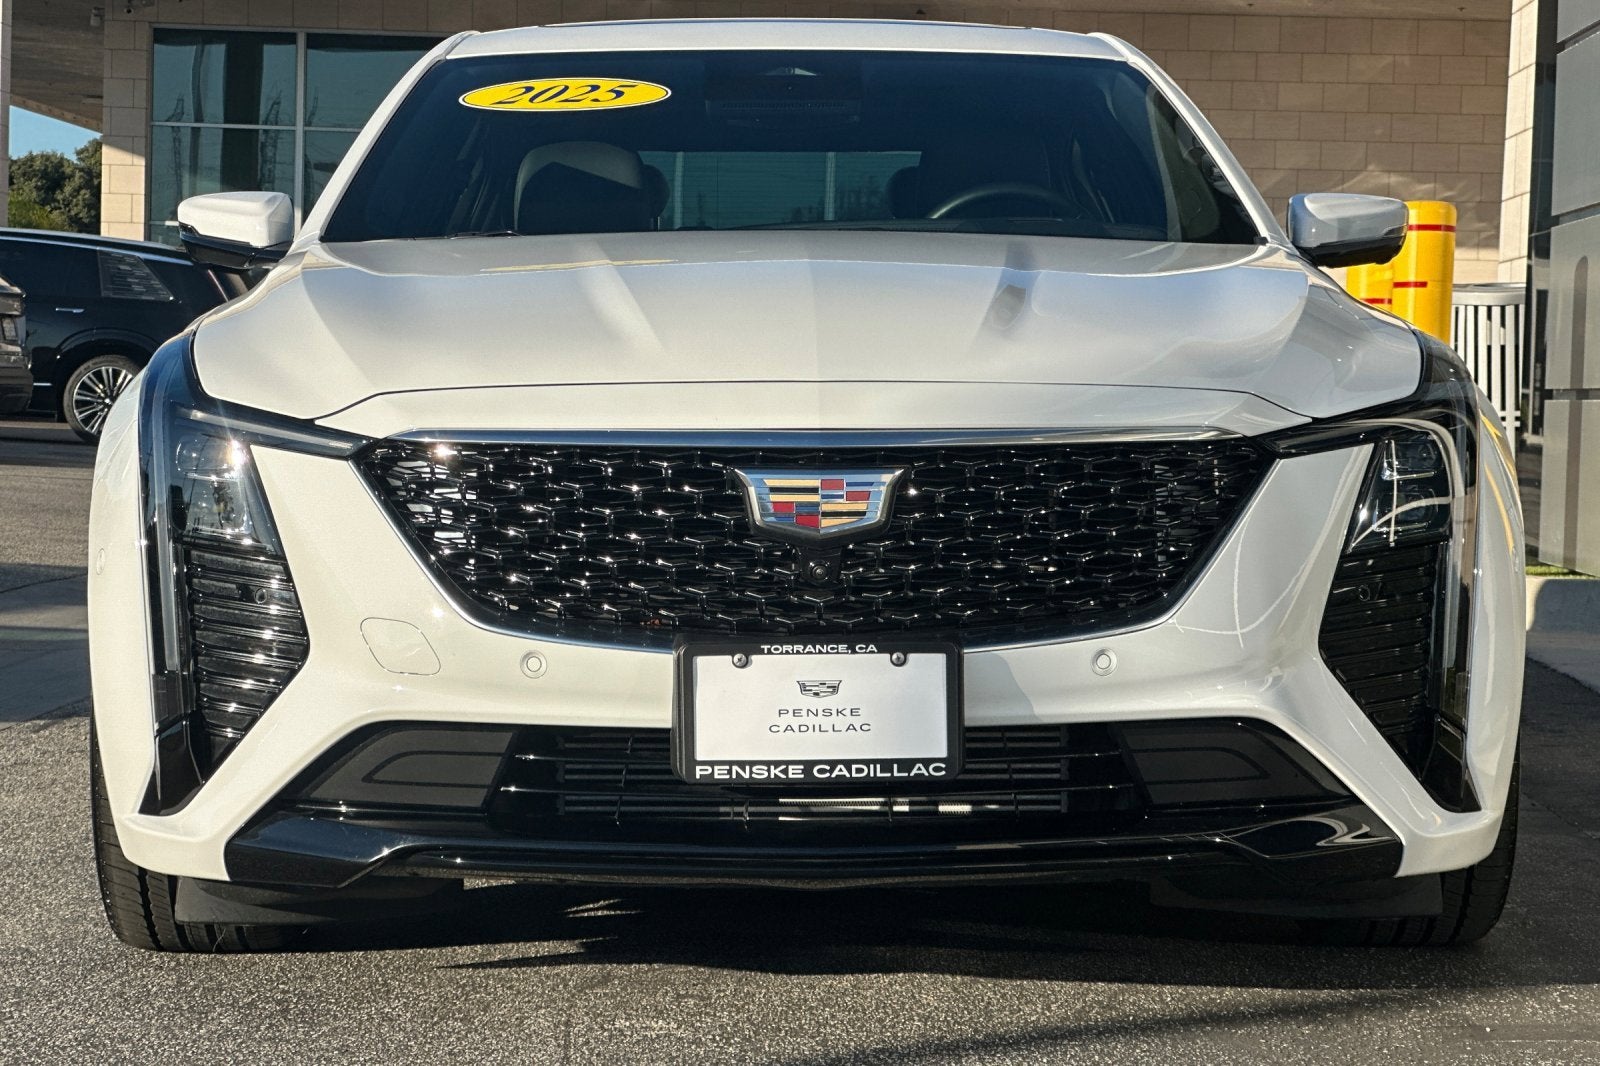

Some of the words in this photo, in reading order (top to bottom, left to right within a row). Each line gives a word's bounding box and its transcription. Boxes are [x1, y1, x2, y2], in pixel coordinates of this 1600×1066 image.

[490, 84, 638, 105] 2025
[760, 644, 851, 655] TORRANCE,
[855, 644, 878, 653] CA
[778, 707, 861, 718] PENSKE
[768, 723, 872, 734] CADILLAC
[695, 764, 805, 780] PENSKE
[812, 762, 946, 779] CADILLAC
